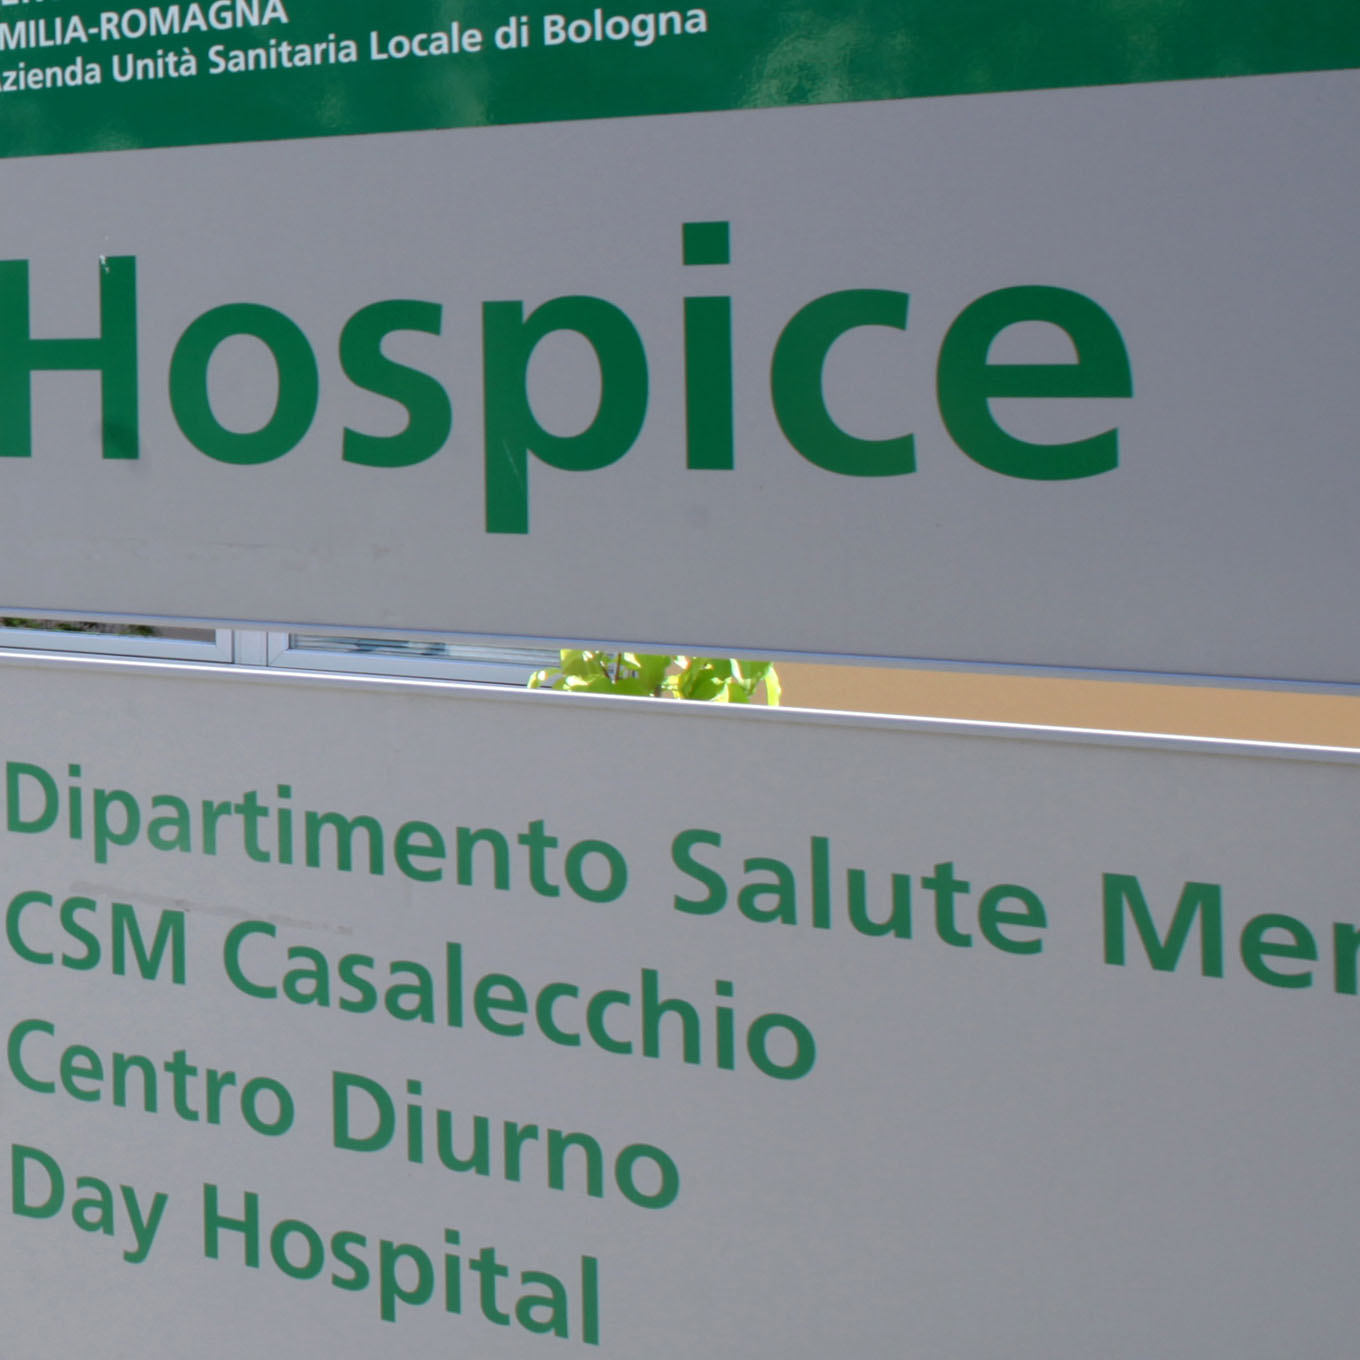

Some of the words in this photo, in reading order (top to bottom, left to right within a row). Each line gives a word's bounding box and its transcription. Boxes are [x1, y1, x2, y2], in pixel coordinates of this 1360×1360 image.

[112, 44, 197, 82] Unità
[208, 40, 358, 74] Sanitaria
[371, 21, 483, 60] Locale
[495, 14, 530, 49] di
[544, 8, 707, 47] Bologna
[7, 761, 629, 905] Dipartimento
[672, 829, 1049, 955] Salute
[7, 891, 188, 986] CSM
[224, 920, 819, 1082] Casalecchio
[8, 1020, 297, 1138] Centro
[333, 1071, 682, 1212] Diurno
[11, 1145, 170, 1266] Day
[203, 1183, 602, 1347] Hospital
